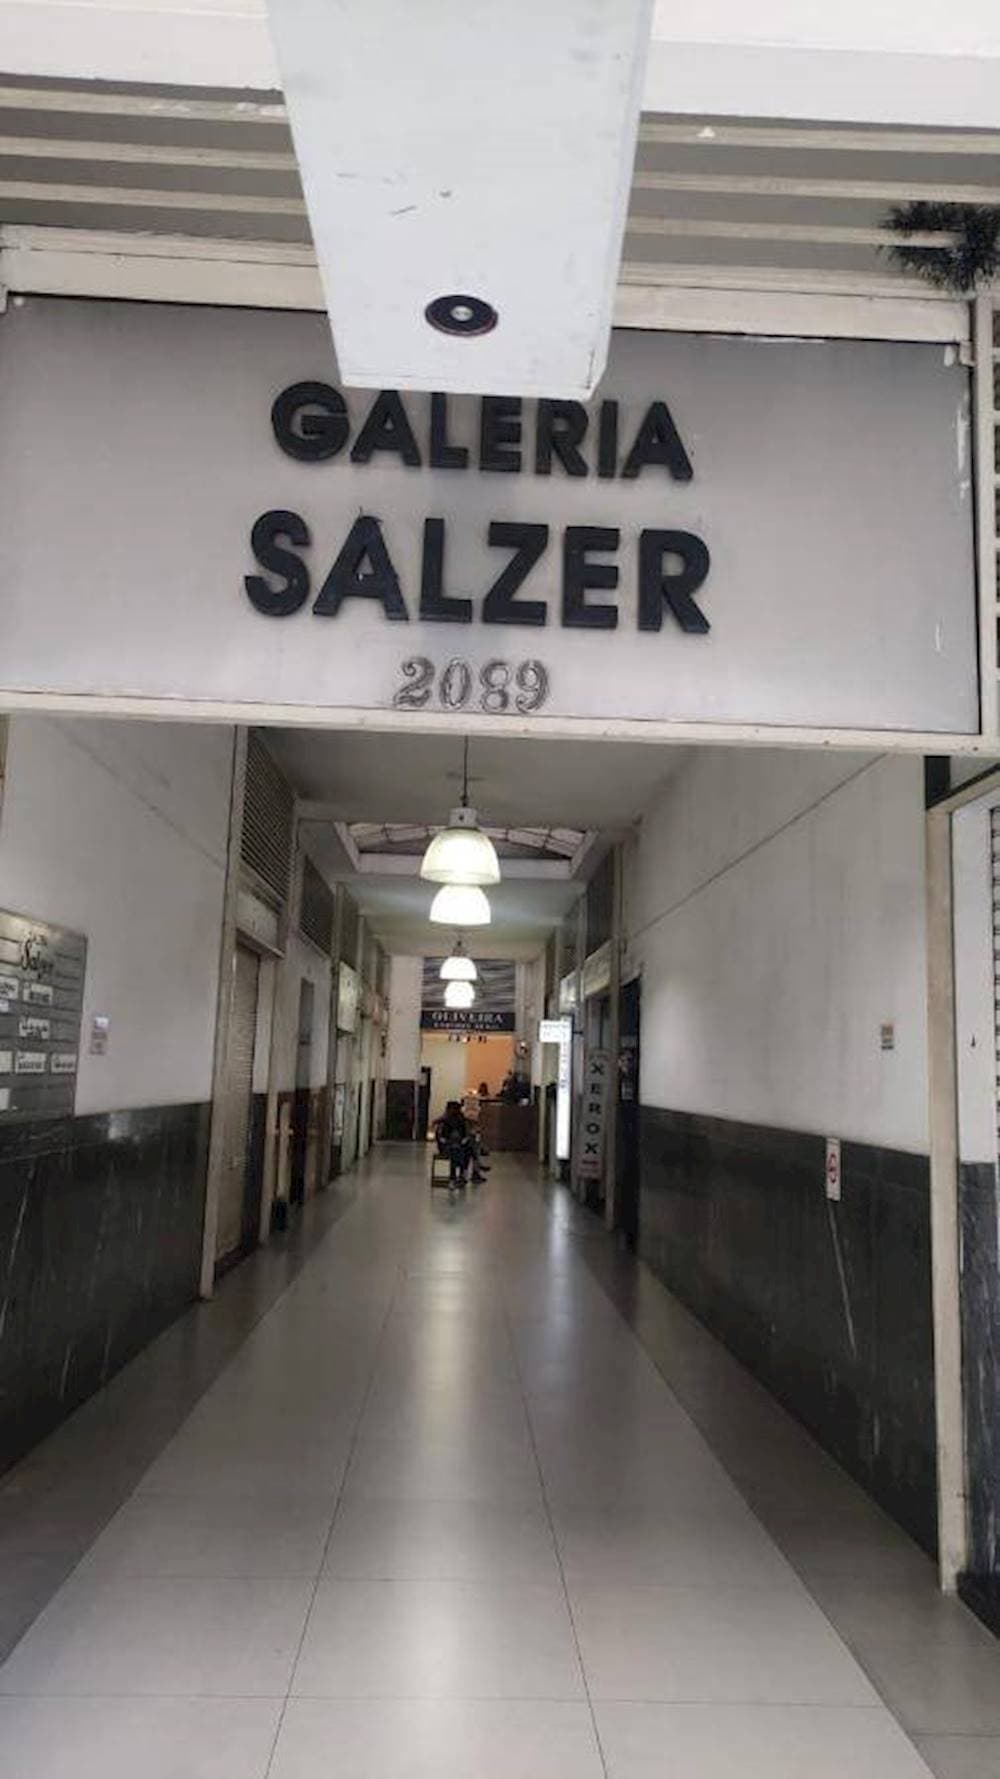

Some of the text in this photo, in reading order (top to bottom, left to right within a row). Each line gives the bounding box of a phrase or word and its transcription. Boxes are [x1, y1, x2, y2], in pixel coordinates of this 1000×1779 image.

[271, 381, 693, 481] GALERIA
[244, 508, 712, 634] SALZER
[393, 656, 550, 714] 2089
[584, 1062, 605, 1155] XEROX
